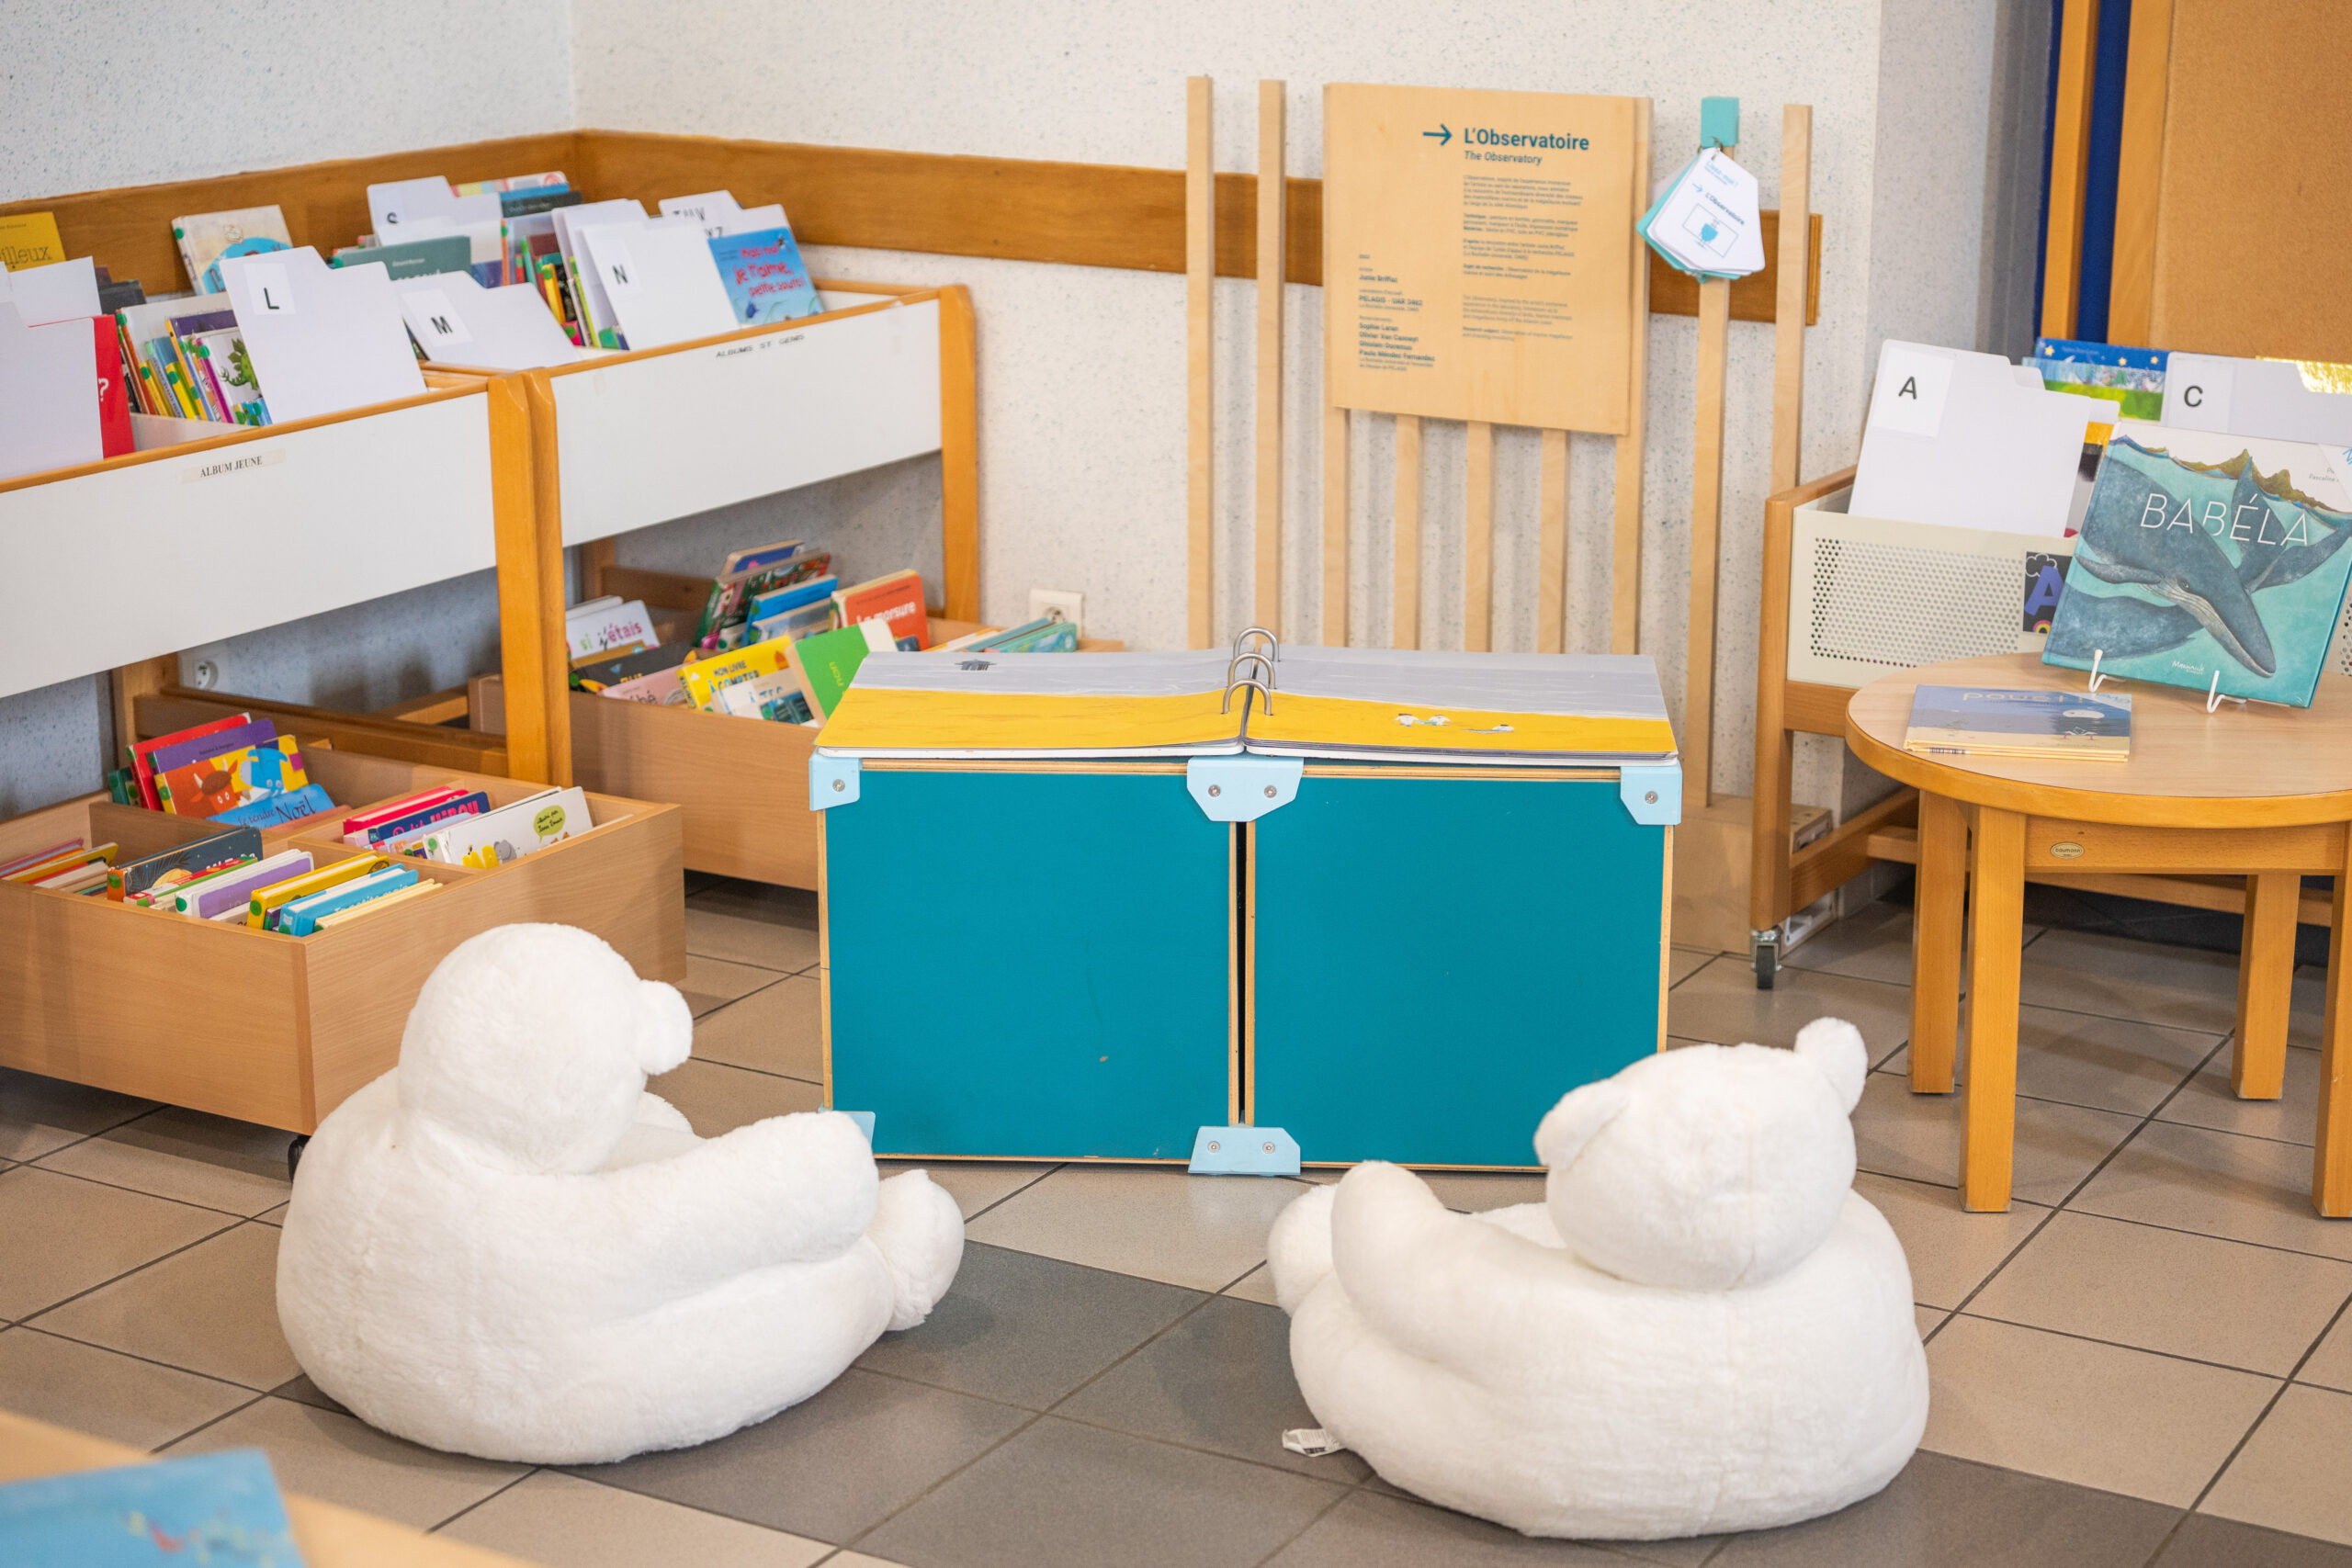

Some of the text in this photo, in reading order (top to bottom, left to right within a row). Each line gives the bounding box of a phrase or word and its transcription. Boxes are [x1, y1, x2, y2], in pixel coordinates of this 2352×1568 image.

[1464, 127, 1589, 151] L'Observatoire
[1464, 150, 1543, 166] The Observatory
[612, 264, 628, 285] N
[263, 287, 280, 310] L
[430, 315, 453, 334] M
[1898, 376, 1917, 400] A
[2183, 385, 2203, 408] C
[200, 456, 263, 478] ALBUM JEUNE
[2141, 492, 2308, 547] BABÉLA
[2024, 565, 2064, 616] A
[713, 666, 729, 677] MON
[276, 794, 316, 824] Noël
